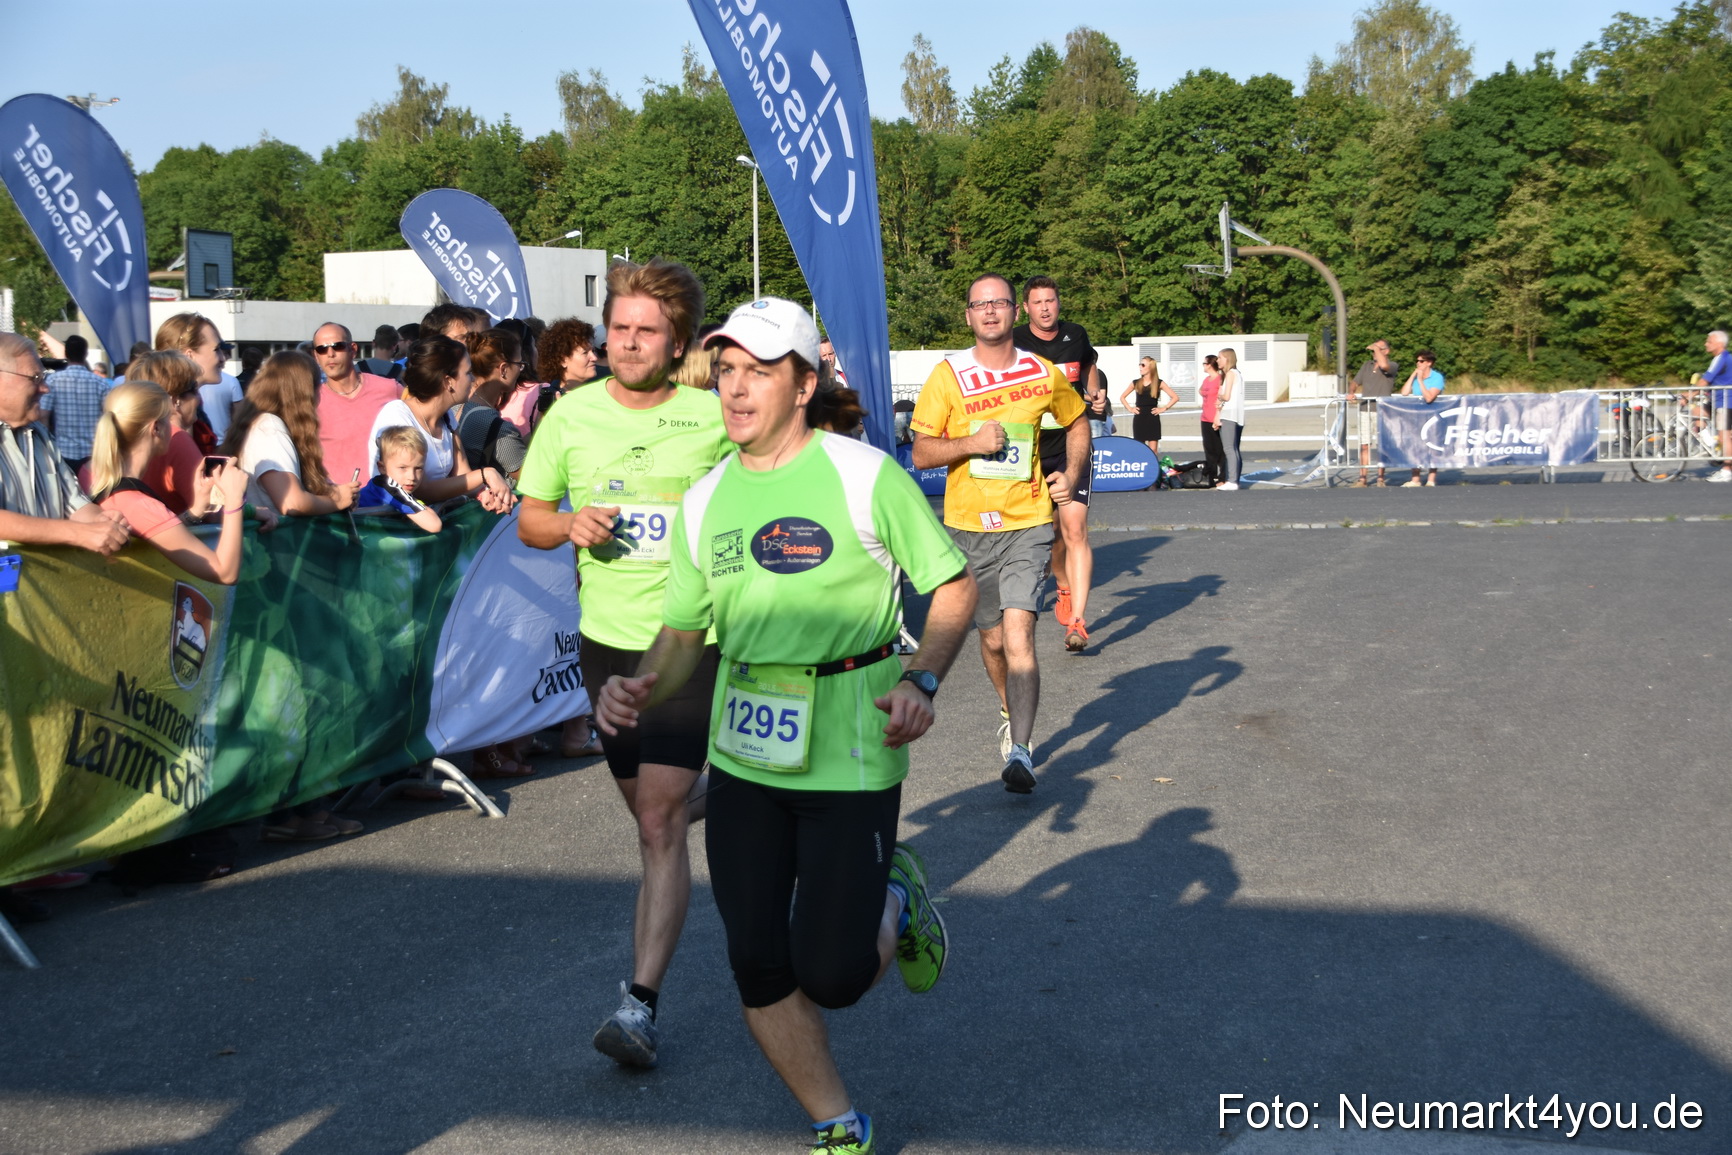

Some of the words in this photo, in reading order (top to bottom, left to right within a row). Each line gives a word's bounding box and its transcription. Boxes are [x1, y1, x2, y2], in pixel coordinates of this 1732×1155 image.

[964, 394, 1005, 415] MAX
[1009, 384, 1052, 402] BÖGL
[670, 420, 699, 428] DEKRA
[1444, 424, 1552, 445] Fischer
[1454, 446, 1543, 456] AUTOMOBILE
[783, 545, 822, 555] Eckstein
[711, 564, 745, 578] RICHTER
[728, 696, 799, 743] 1295
[748, 743, 764, 753] Keck
[874, 831, 883, 862] Reebok
